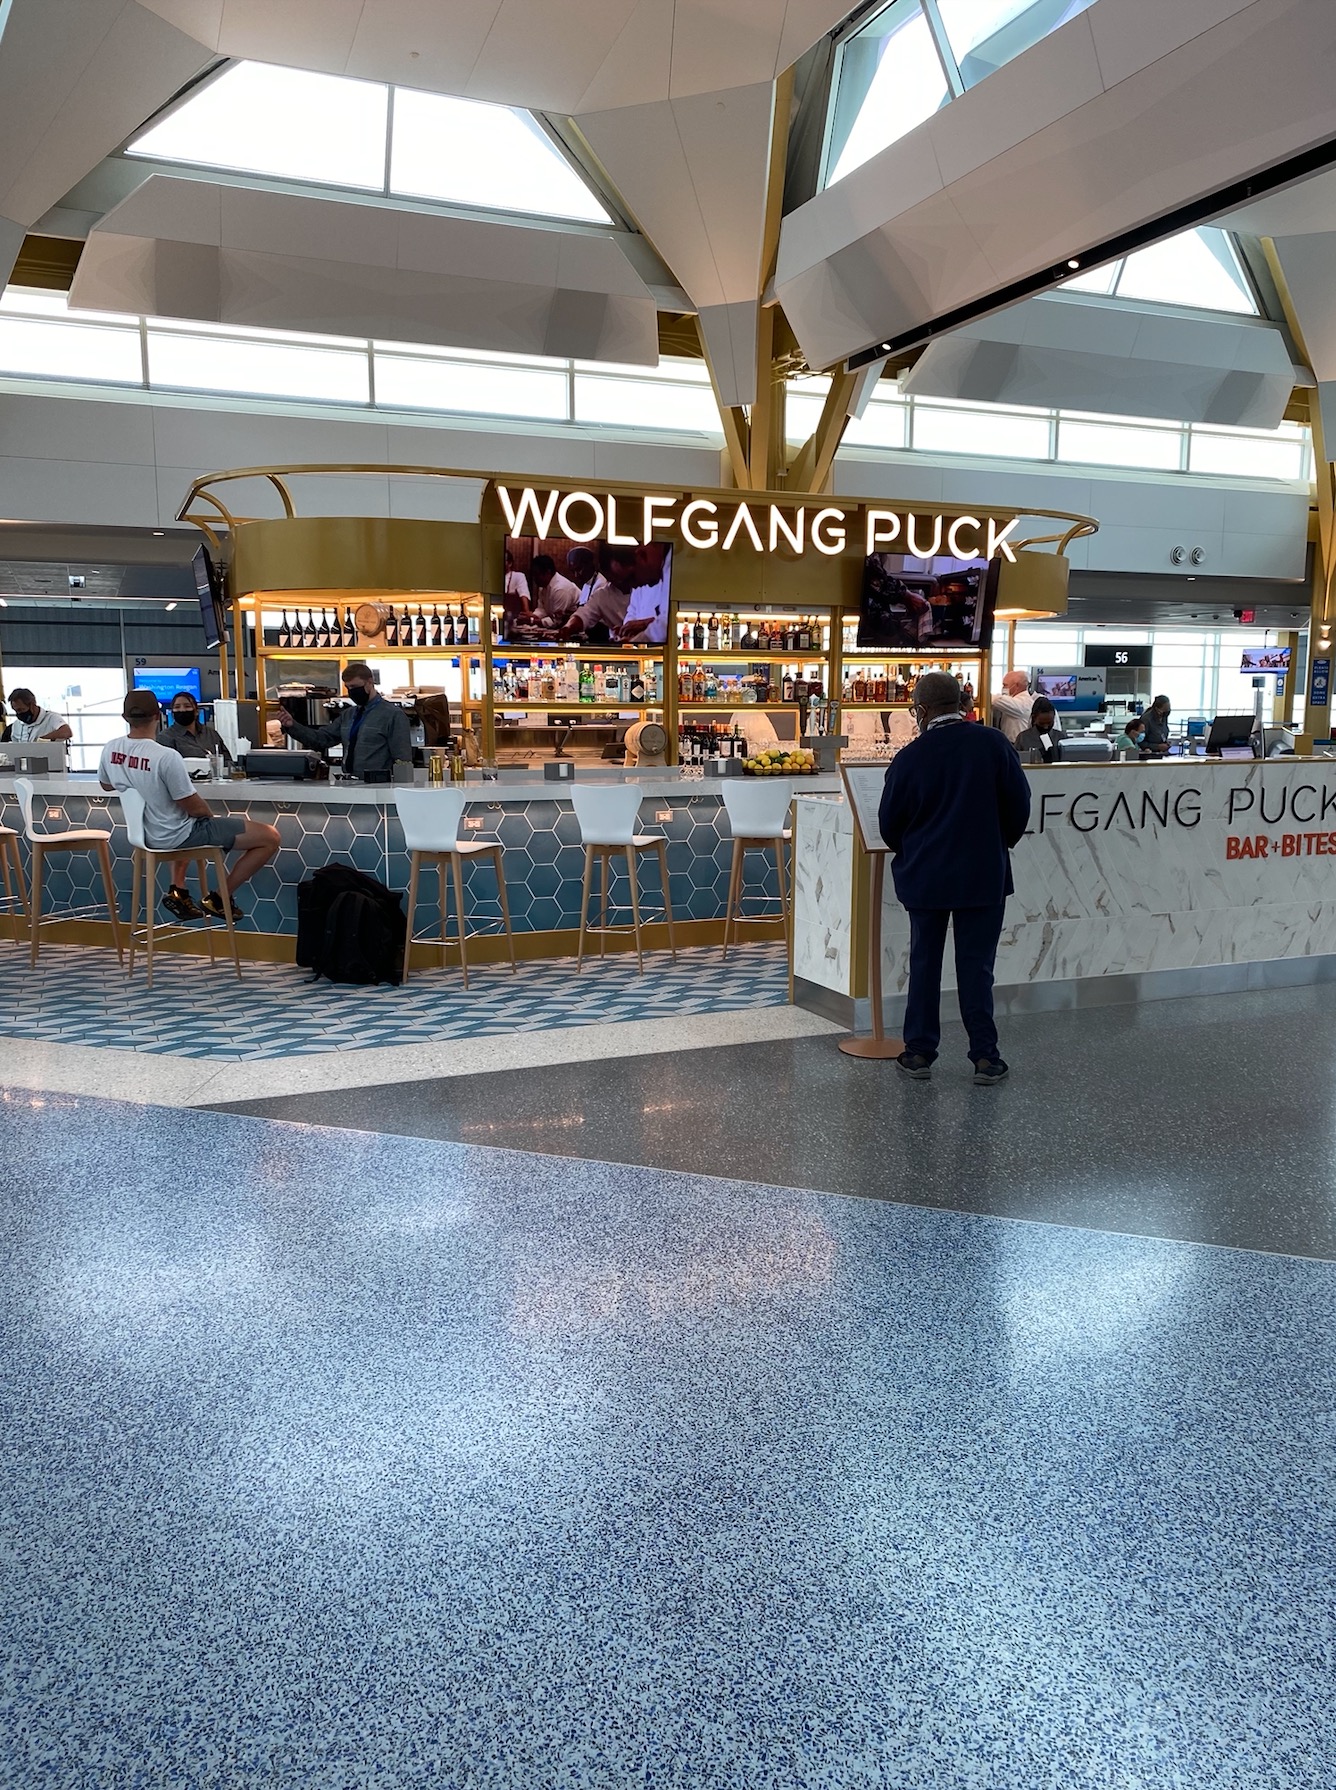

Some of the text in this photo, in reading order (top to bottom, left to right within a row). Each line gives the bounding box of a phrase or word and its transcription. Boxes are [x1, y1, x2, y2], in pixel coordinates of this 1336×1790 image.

[497, 486, 1020, 563] WOLFGANG PUCK
[136, 658, 146, 666] 59
[1115, 651, 1128, 664] 56
[128, 755, 139, 769] DO
[1024, 788, 1202, 834] FGANG
